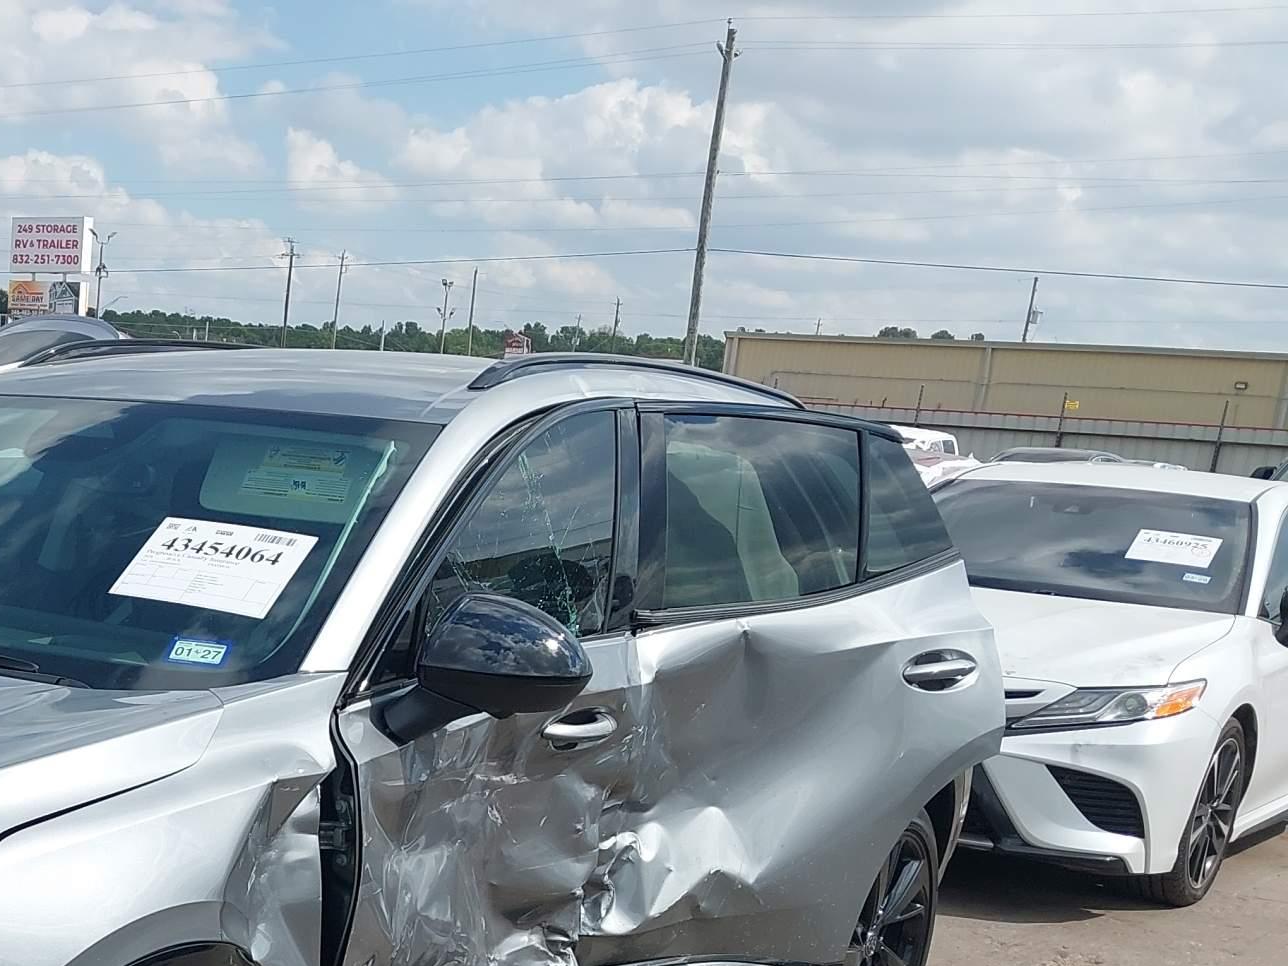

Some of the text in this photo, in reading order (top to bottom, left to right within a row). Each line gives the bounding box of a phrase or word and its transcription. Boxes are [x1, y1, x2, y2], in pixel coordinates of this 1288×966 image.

[17, 224, 78, 234] 249 STORAGE
[36, 239, 79, 250] TRAILER
[12, 254, 79, 265] 832-251-7300
[161, 536, 284, 565] 43454064
